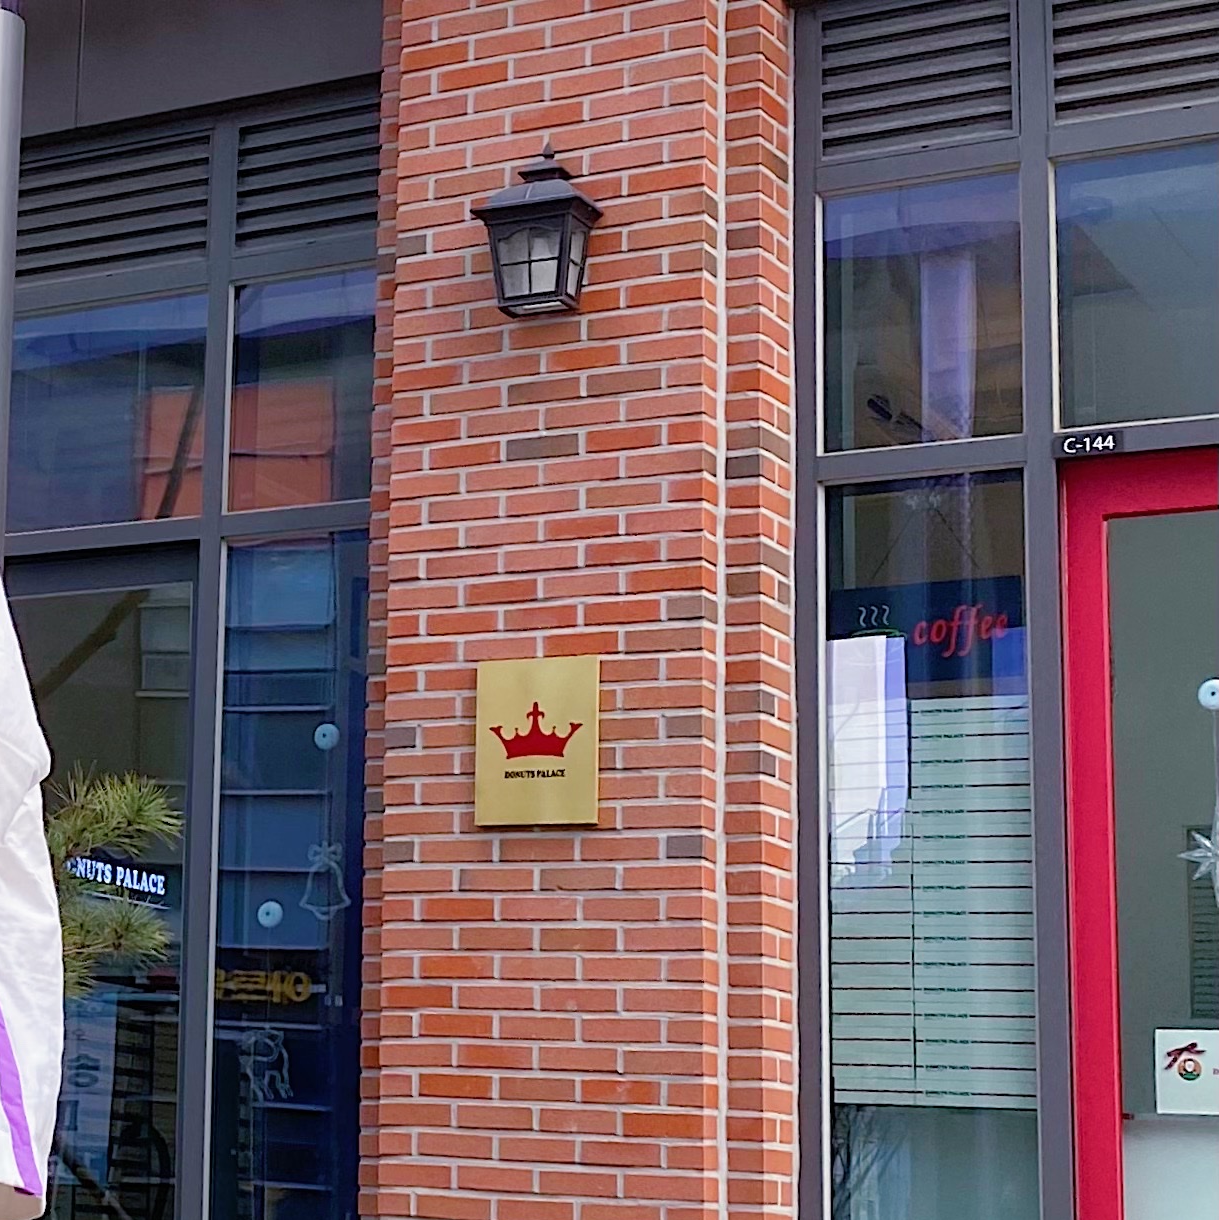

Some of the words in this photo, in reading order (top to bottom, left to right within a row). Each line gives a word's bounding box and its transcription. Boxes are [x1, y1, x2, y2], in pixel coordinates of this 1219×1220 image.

[1063, 435, 1116, 453] C-144
[913, 604, 1008, 658] coffee
[504, 770, 535, 779] DONUTS
[536, 768, 566, 778] PALACE
[116, 866, 166, 895] PALACE
